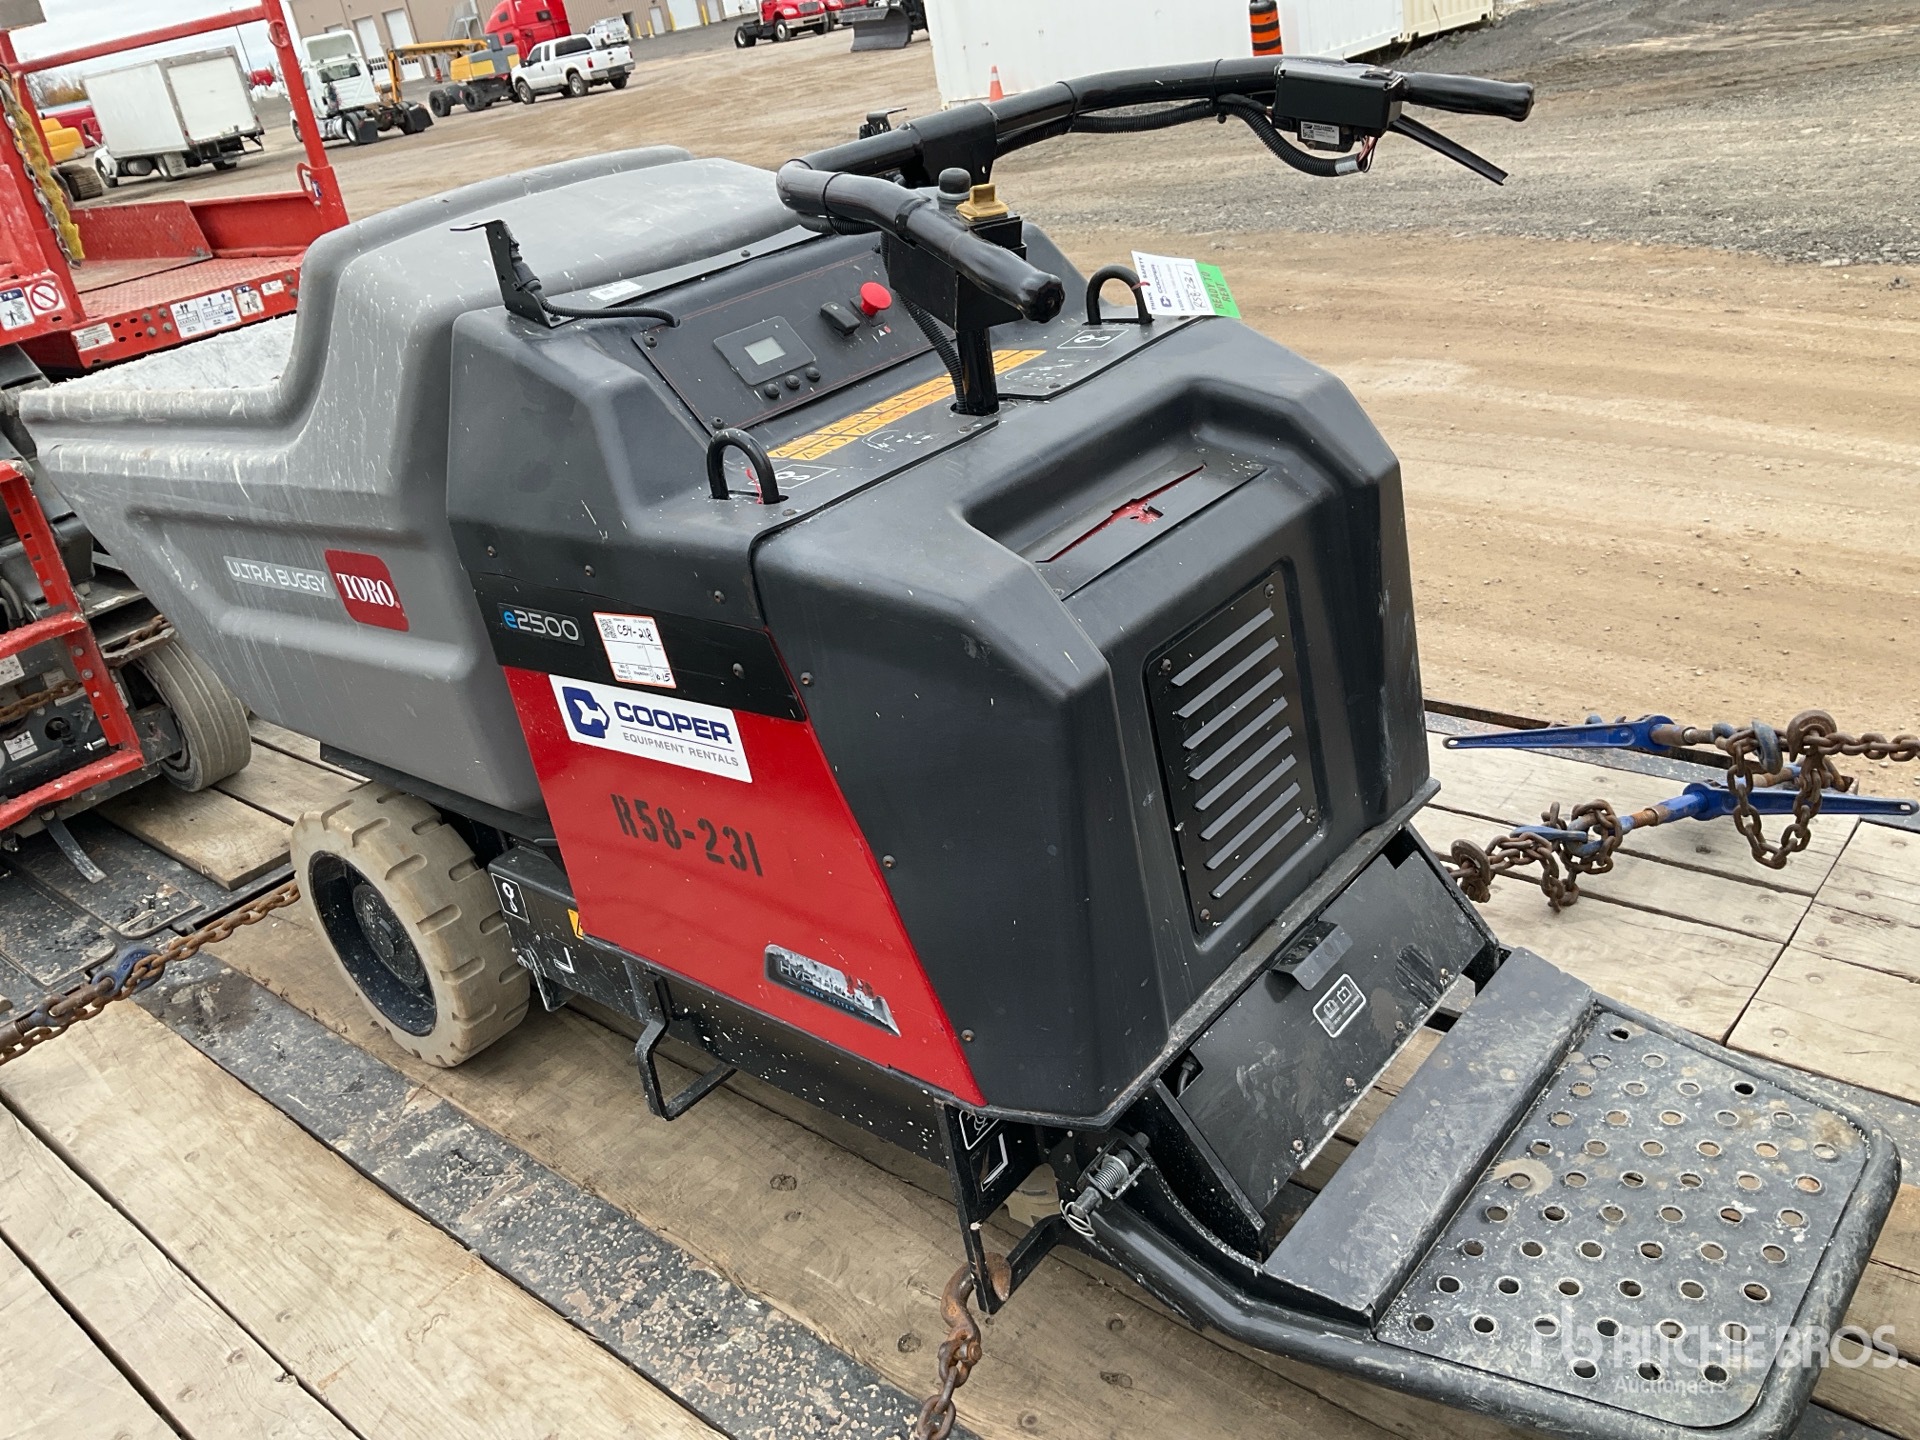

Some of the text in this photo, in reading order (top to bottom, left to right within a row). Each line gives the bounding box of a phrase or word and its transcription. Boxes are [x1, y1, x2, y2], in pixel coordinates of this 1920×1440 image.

[1201, 271, 1225, 309] READY TO
[1216, 282, 1231, 302] RENT
[227, 560, 328, 593] ULTRA BUGGY
[503, 610, 579, 641] e2500
[614, 701, 733, 745] COOPER
[622, 732, 739, 767] EQUIPMENT RENTALS
[610, 793, 764, 878] R58-231
[800, 984, 825, 999] POWER
